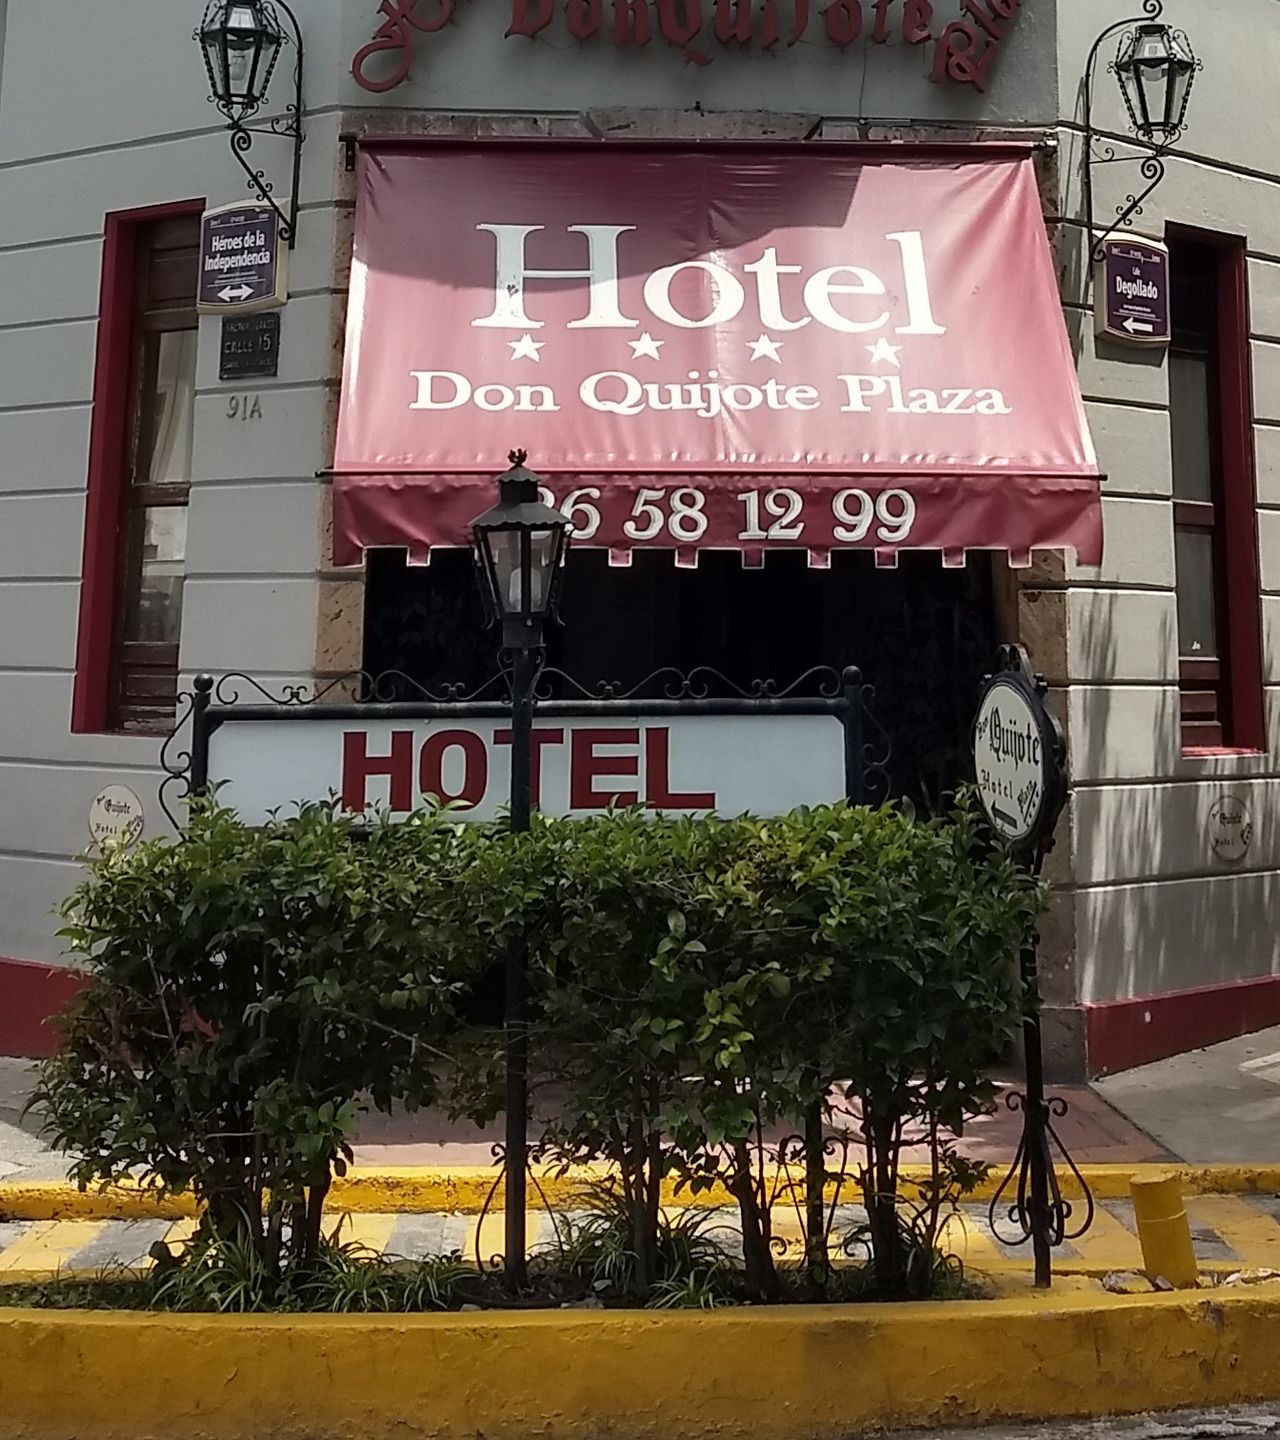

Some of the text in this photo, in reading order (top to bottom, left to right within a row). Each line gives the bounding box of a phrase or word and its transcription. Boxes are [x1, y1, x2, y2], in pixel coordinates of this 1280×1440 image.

[204, 247, 271, 273] Independencia
[211, 229, 265, 252] Héroes de la
[471, 222, 946, 336] Hotel
[1116, 275, 1158, 300] Degollado
[409, 371, 1013, 417] Don Quijote Plaza
[623, 488, 709, 541] 58
[737, 489, 805, 541] 12
[832, 489, 916, 542] 99
[989, 707, 1040, 771] Quijote
[341, 726, 716, 814] HOTEL
[981, 769, 1013, 800] Hotel
